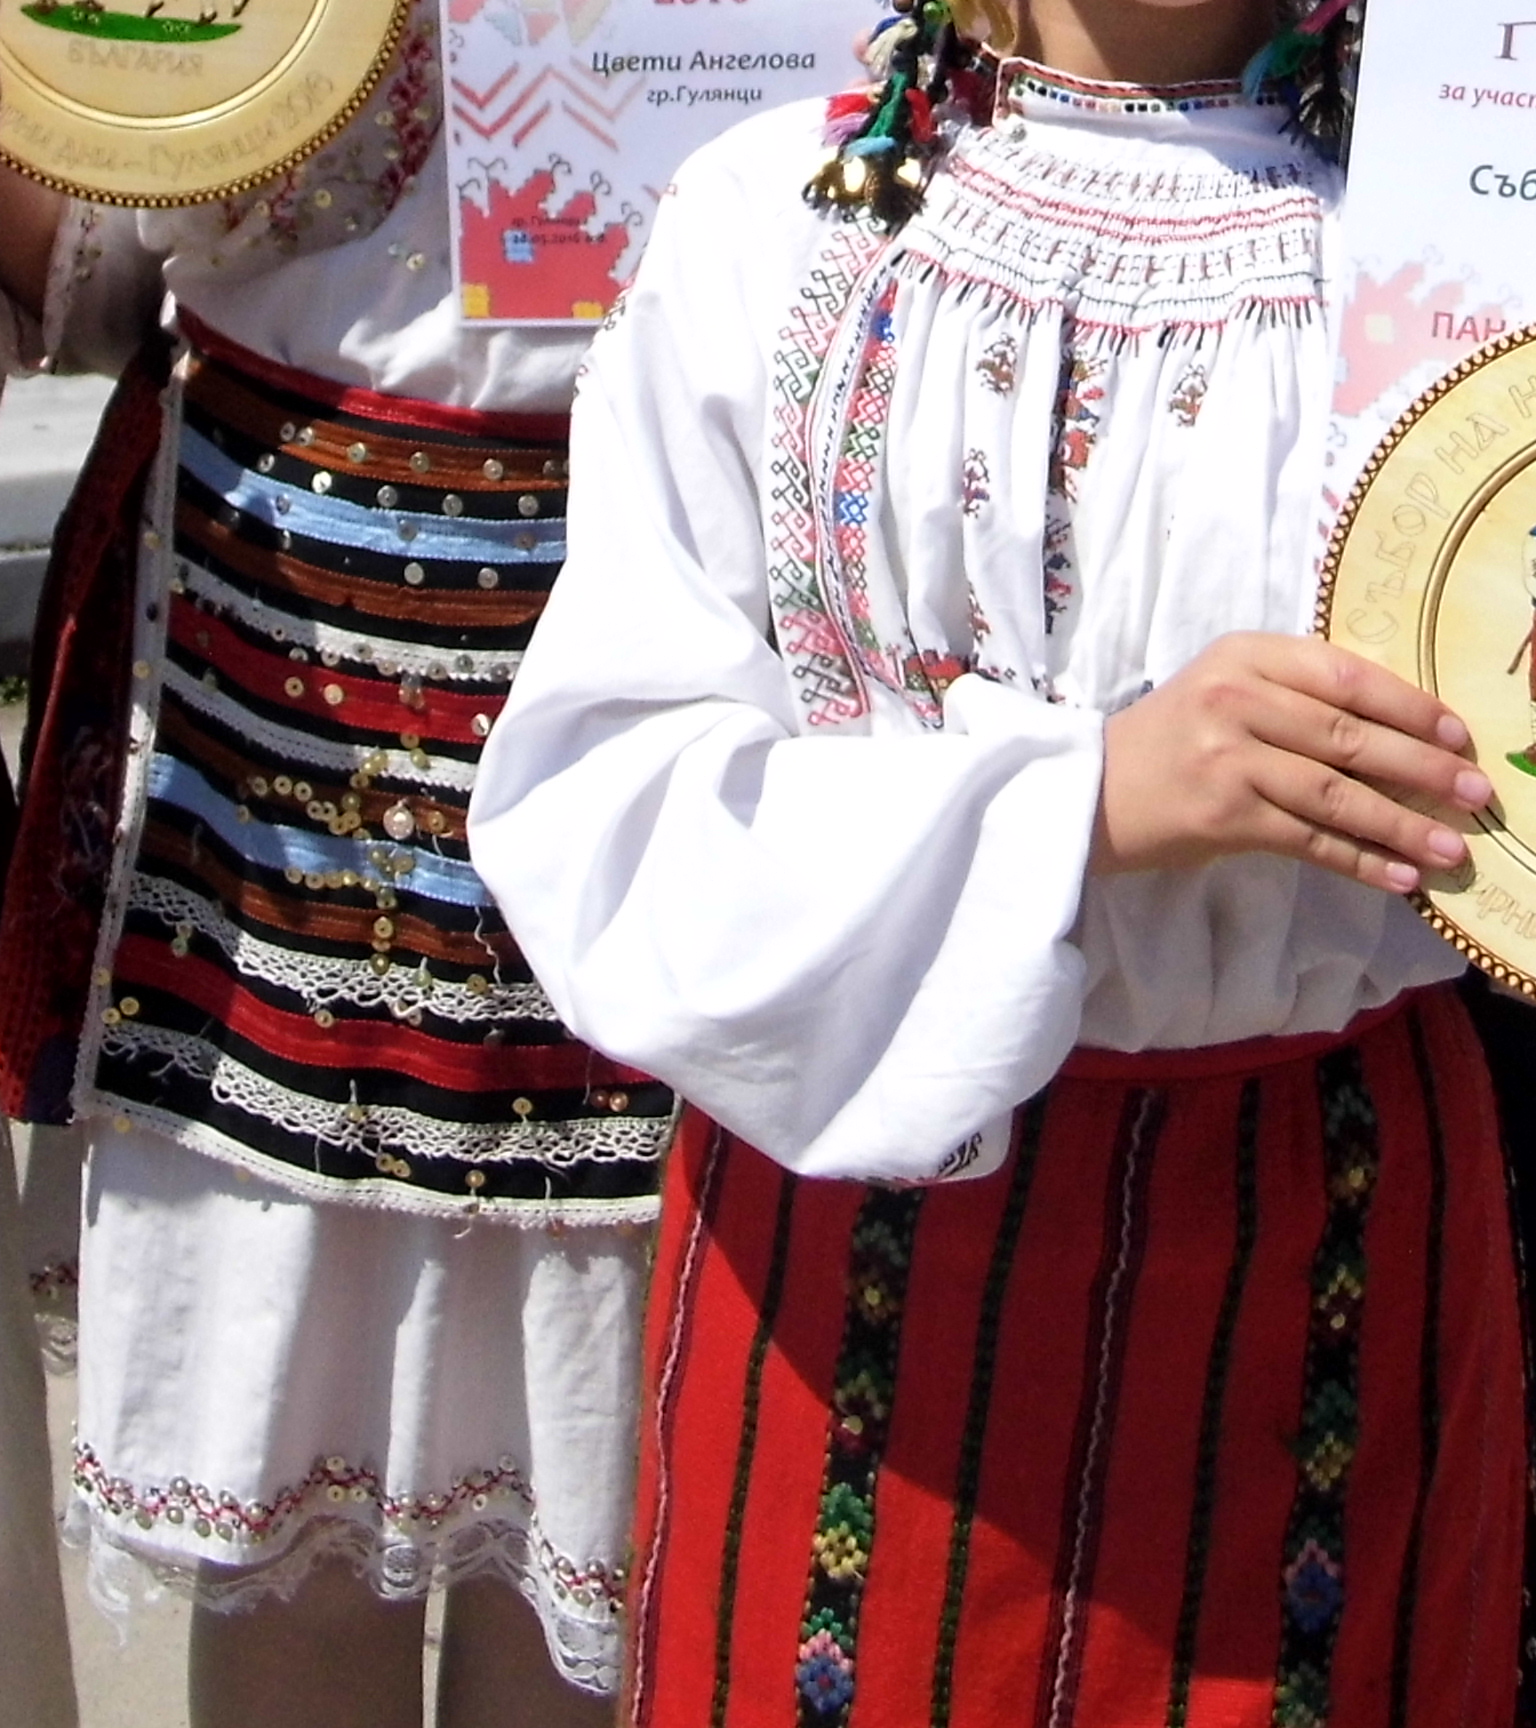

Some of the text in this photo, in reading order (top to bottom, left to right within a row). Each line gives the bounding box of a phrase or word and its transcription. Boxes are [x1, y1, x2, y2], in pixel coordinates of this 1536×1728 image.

[592, 50, 816, 77] Цвети Ангелова
[1437, 82, 1468, 102] за
[1346, 471, 1451, 644] СЪБОР
[1434, 412, 1509, 475] НА
